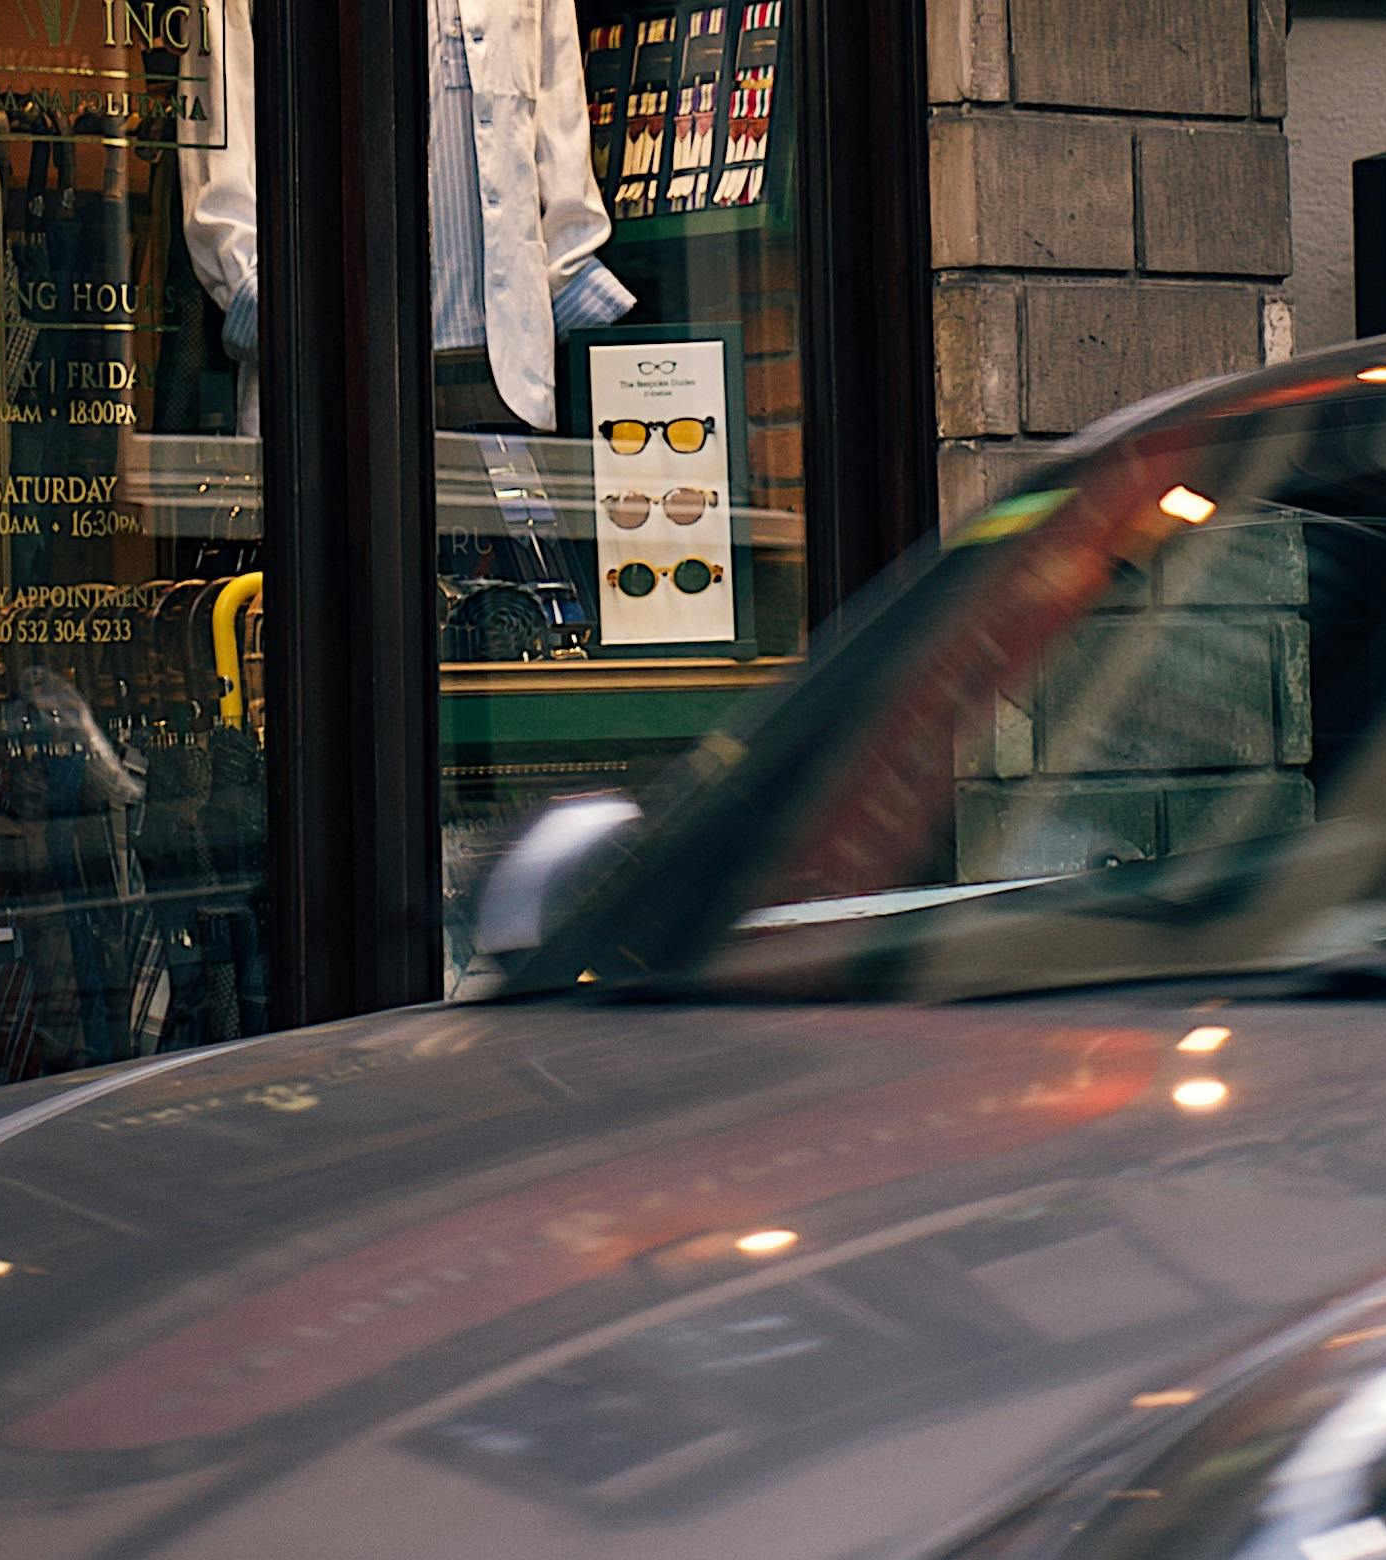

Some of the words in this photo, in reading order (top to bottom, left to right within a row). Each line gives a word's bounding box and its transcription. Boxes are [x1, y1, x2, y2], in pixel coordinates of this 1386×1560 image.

[13, 585, 160, 610] APPOINTMENT
[17, 620, 48, 643] 532
[53, 620, 86, 643] 304
[91, 619, 132, 643] 5233
